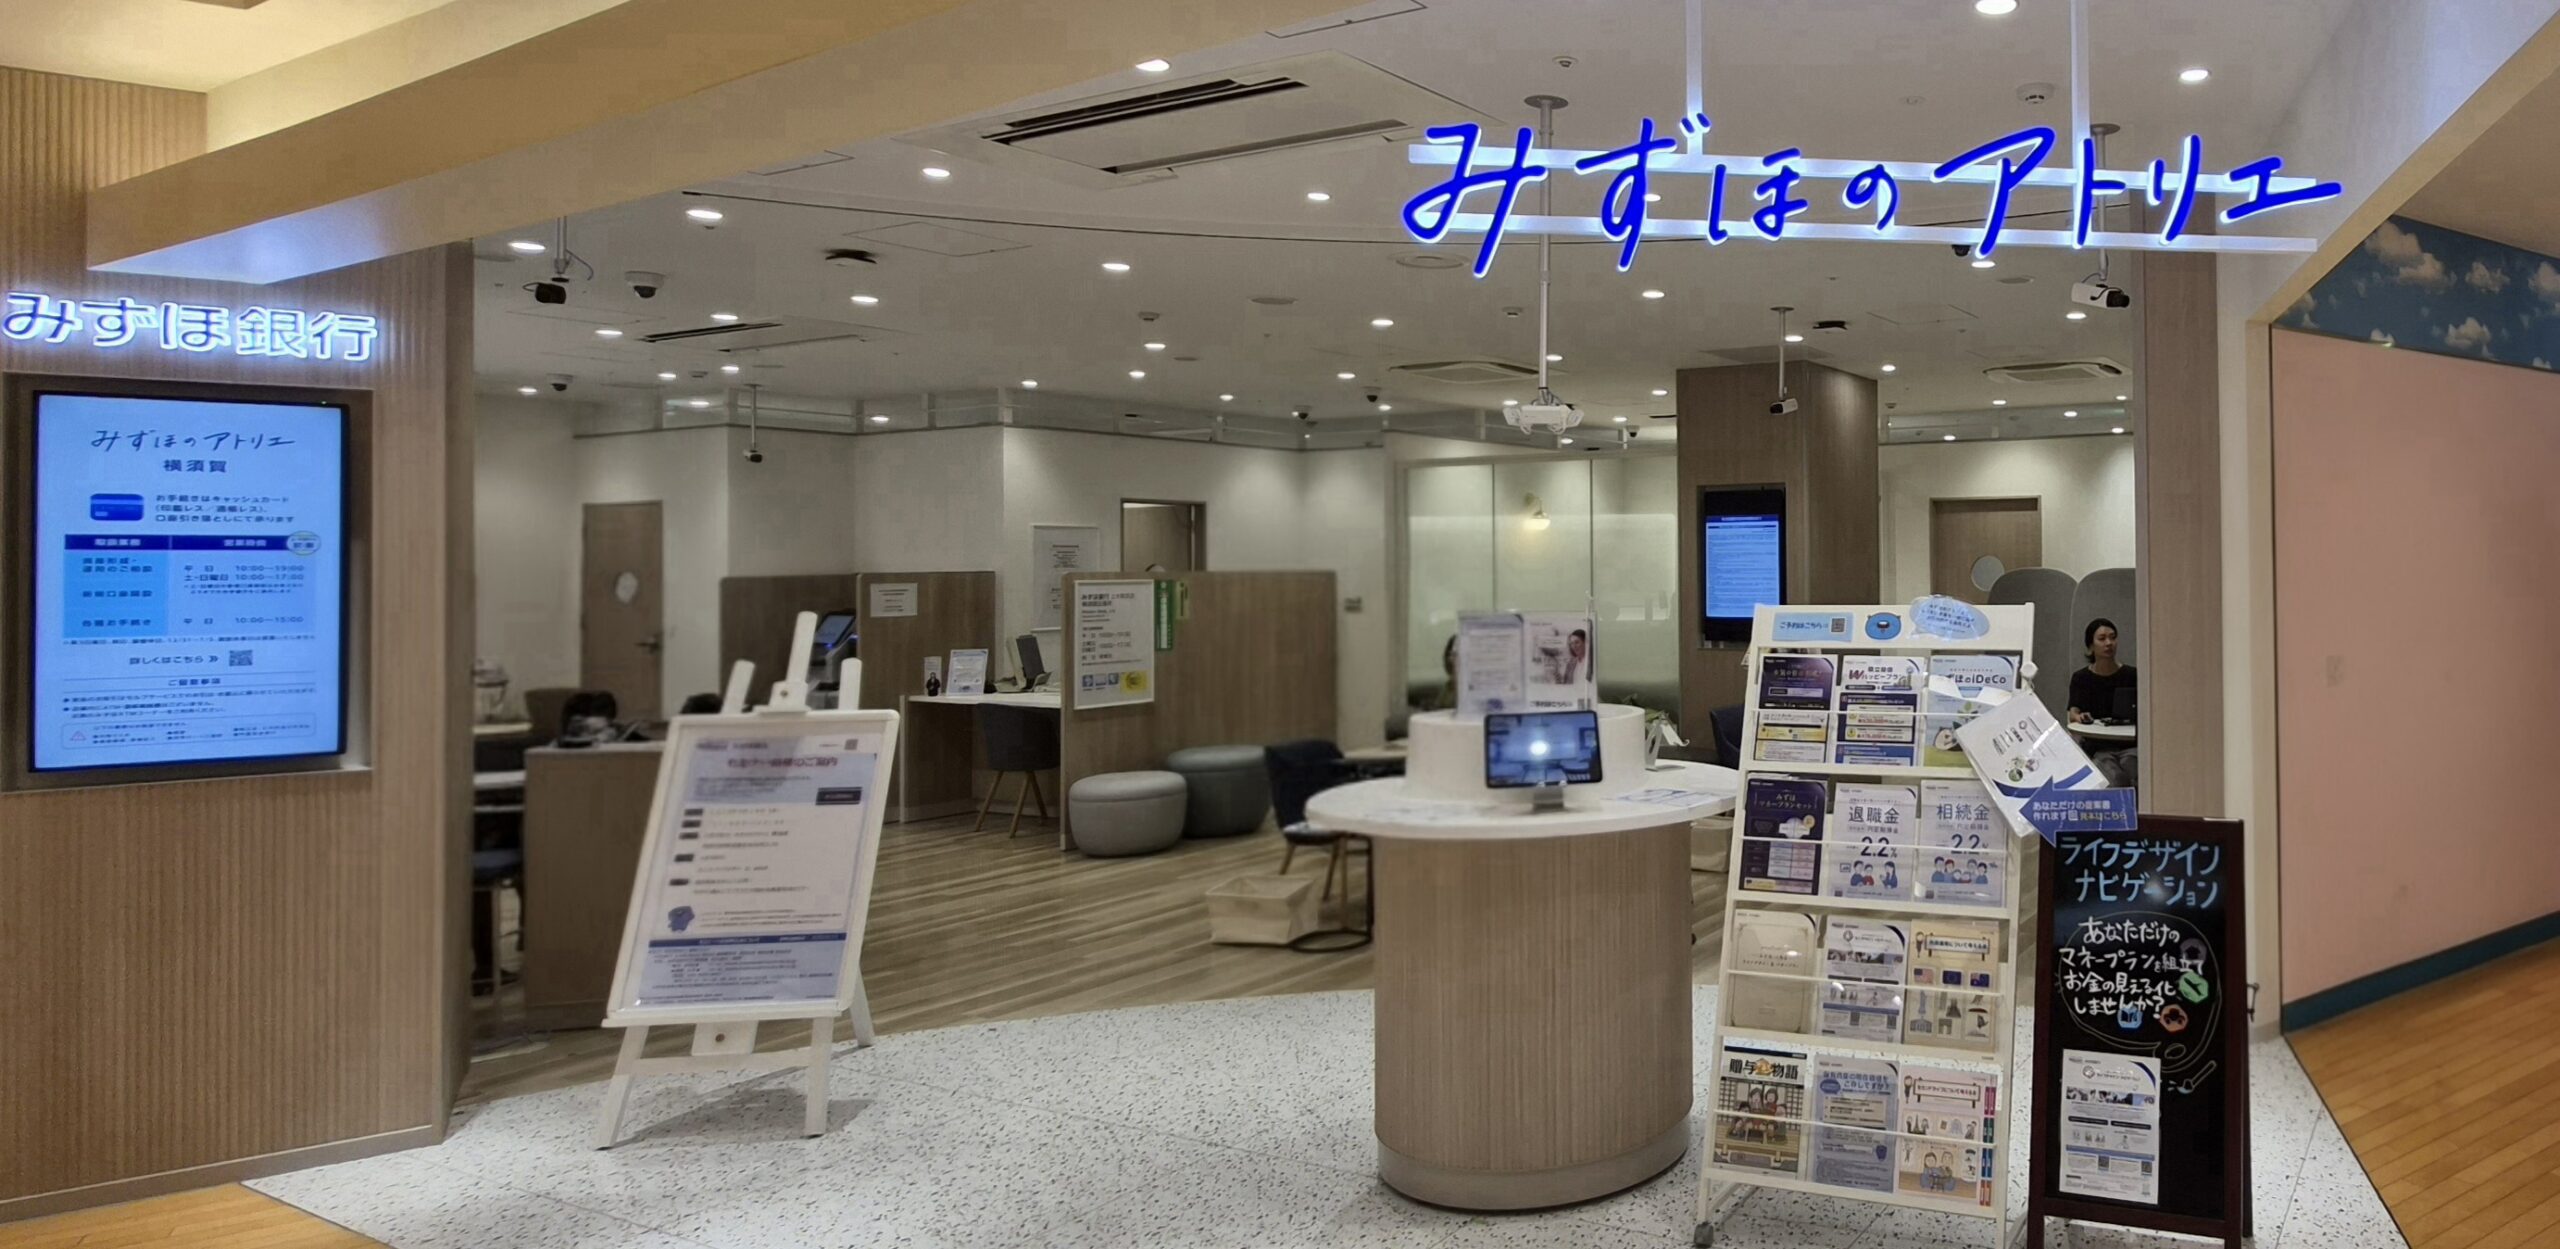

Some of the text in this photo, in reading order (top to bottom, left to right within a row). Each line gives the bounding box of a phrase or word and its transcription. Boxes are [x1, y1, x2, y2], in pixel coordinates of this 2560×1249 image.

[1402, 112, 2342, 276] みずほのアトリエ
[2, 291, 378, 361] みずほ銀行
[90, 429, 297, 451] みずほのアトリエ
[163, 459, 227, 474] 横須賀
[1848, 805, 1900, 825] 退職金
[1936, 803, 1990, 821] 相続金
[2060, 837, 2220, 877] ライフデザイン
[2075, 868, 2218, 909] ナビゲーション
[2077, 916, 2181, 947] あなただけの
[2058, 946, 2204, 976] マネープランを組立て
[2063, 969, 2177, 998] お金の見える化
